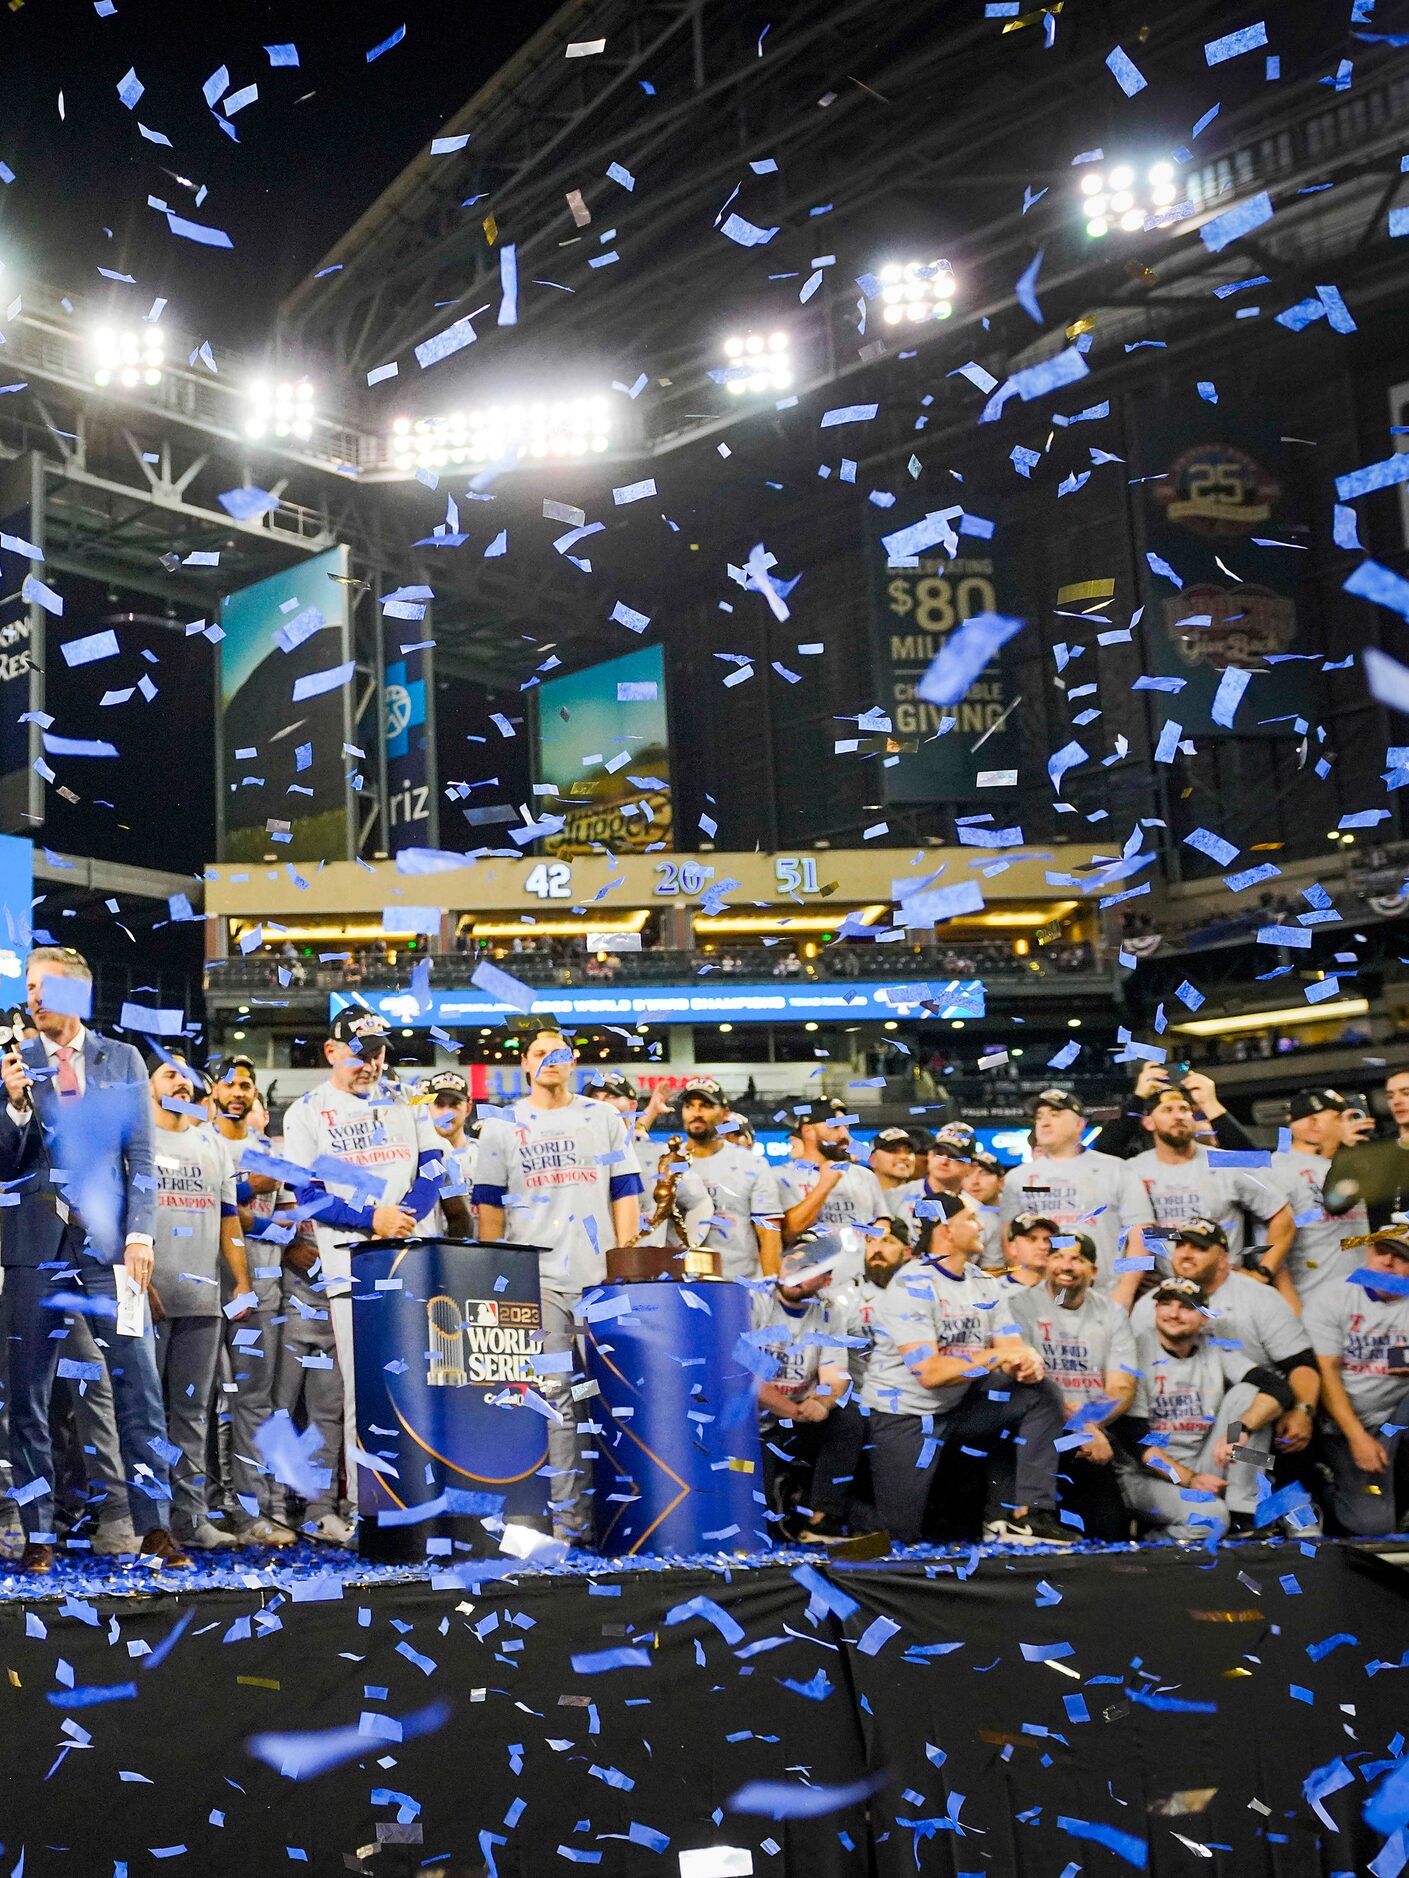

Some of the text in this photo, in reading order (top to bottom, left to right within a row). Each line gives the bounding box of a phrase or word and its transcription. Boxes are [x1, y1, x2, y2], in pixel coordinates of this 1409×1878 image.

[1188, 462, 1244, 504] 25
[888, 576, 997, 632] $80
[896, 704, 1006, 734] GIVING
[525, 863, 572, 899] 42
[654, 860, 707, 896] 20
[775, 857, 821, 893] 51
[320, 1109, 338, 1127] T
[327, 1119, 385, 1141] WORLD
[518, 1139, 576, 1160] WORLD
[521, 1152, 578, 1175] SERIES
[524, 1169, 599, 1190] CHAMPIONS
[499, 1307, 541, 1324] 2023
[859, 1306, 874, 1323] T
[466, 1327, 544, 1355] WORLD
[1038, 1321, 1052, 1342] T
[1154, 1376, 1167, 1394] T
